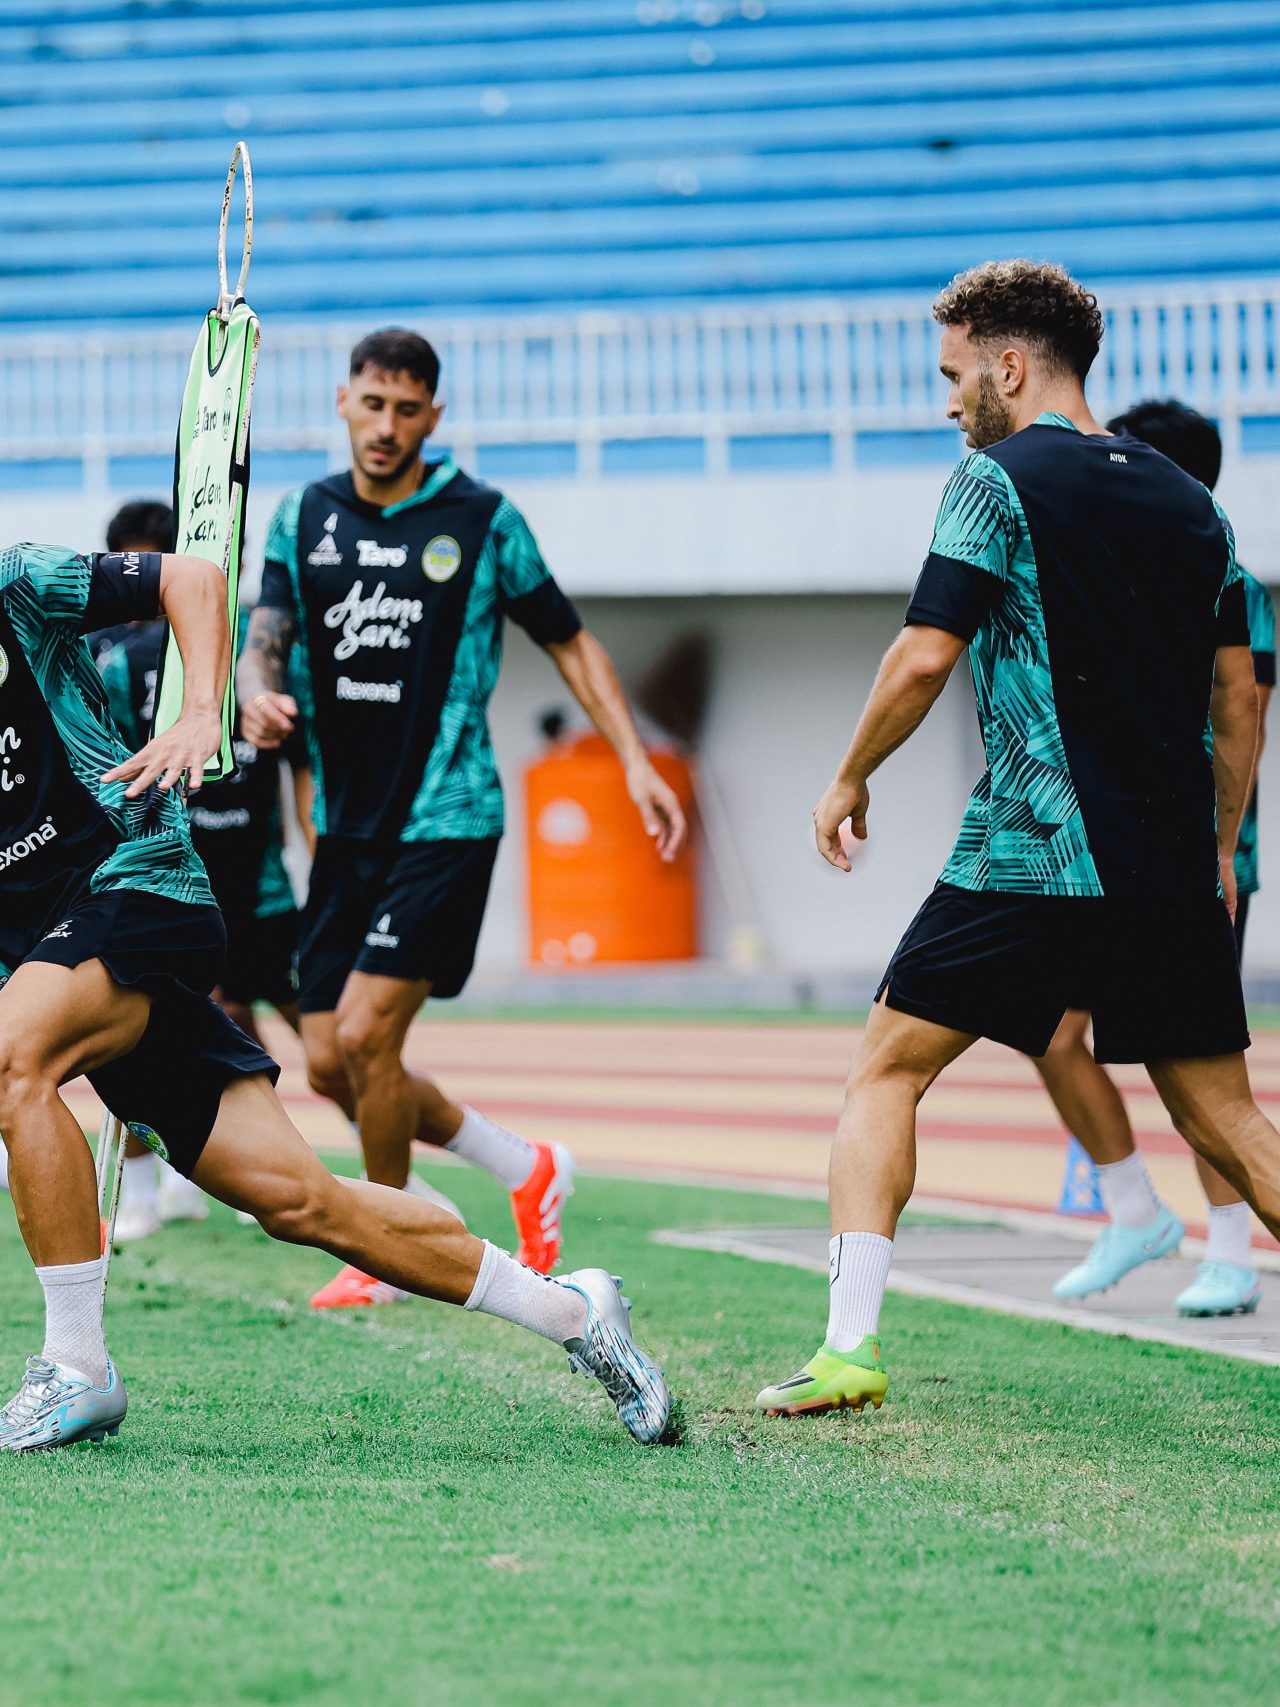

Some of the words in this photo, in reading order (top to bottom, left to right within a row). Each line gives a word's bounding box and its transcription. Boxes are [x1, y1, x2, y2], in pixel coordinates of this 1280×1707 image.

[356, 539, 407, 568] Taro
[323, 579, 424, 629] Adem
[333, 614, 404, 661] Sari
[336, 676, 401, 704] Rexona
